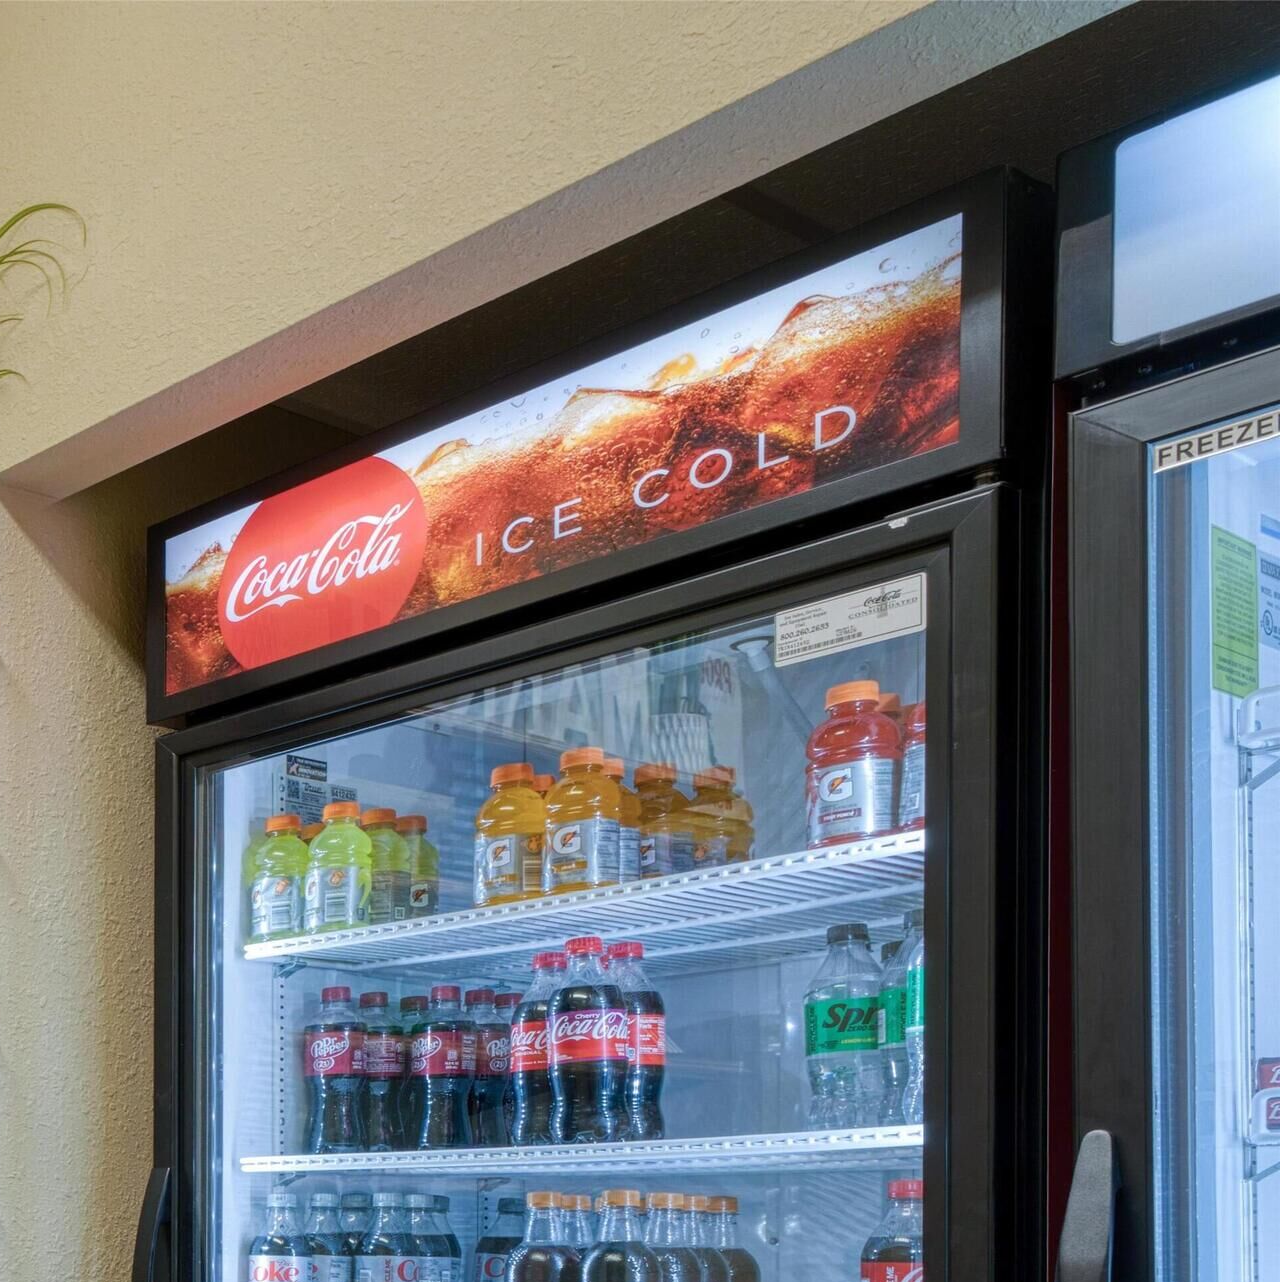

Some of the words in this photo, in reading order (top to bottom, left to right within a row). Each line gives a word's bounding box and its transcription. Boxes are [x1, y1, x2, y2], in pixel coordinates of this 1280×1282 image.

[475, 499, 582, 566] ICE
[634, 405, 858, 509] COLD
[226, 497, 414, 623] Coca-Cola
[820, 768, 852, 801] G
[487, 839, 511, 867] G
[553, 825, 581, 854] G
[552, 1012, 628, 1043] Coca-Cola
[822, 1003, 880, 1032] Spr
[511, 1027, 547, 1049] Coca-C
[886, 1266, 894, 1279] ME
